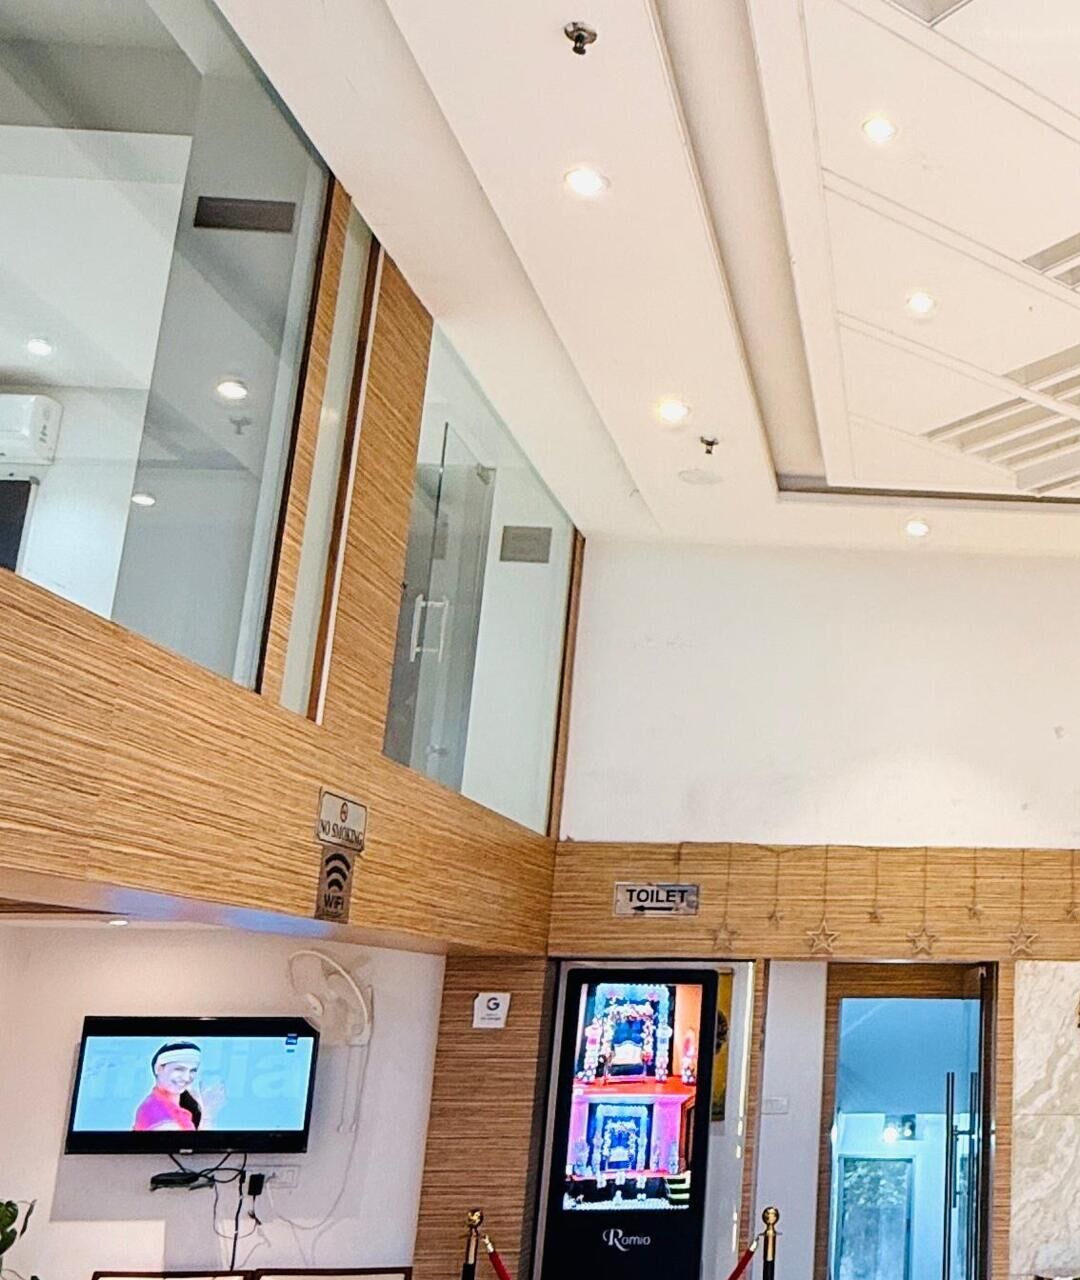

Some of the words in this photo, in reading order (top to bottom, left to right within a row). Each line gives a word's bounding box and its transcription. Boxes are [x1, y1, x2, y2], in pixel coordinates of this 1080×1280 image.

[320, 820, 331, 836] NO
[331, 823, 363, 845] SMOKING
[626, 889, 688, 903] TOILET
[487, 997, 500, 1011] G
